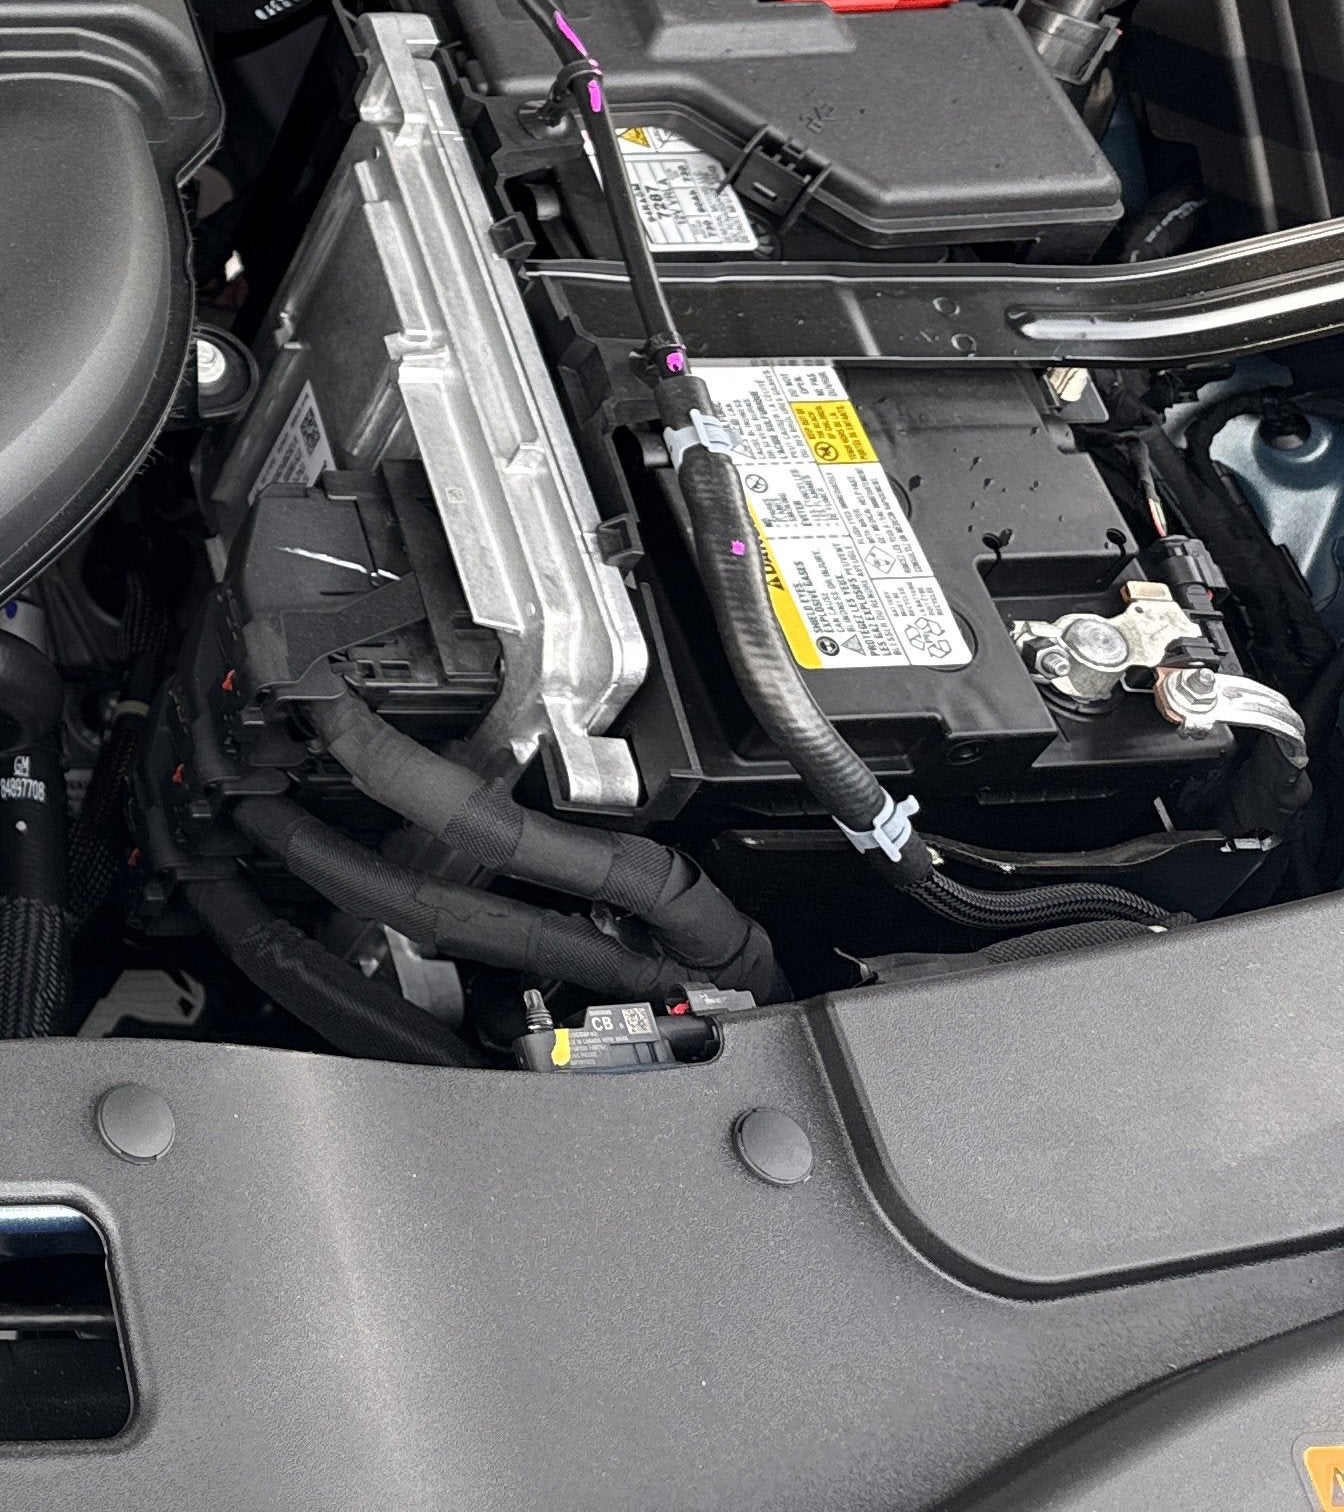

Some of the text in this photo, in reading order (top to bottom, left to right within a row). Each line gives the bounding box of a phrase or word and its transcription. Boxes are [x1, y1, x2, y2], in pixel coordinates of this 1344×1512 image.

[792, 560, 834, 632] EXPLOSIVE GASES
[845, 598, 860, 611] LES
[802, 605, 823, 632] SHIELD
[868, 623, 883, 638] GAZ
[877, 641, 891, 655] LES
[13, 755, 31, 776] GM
[591, 1016, 614, 1031] CB
